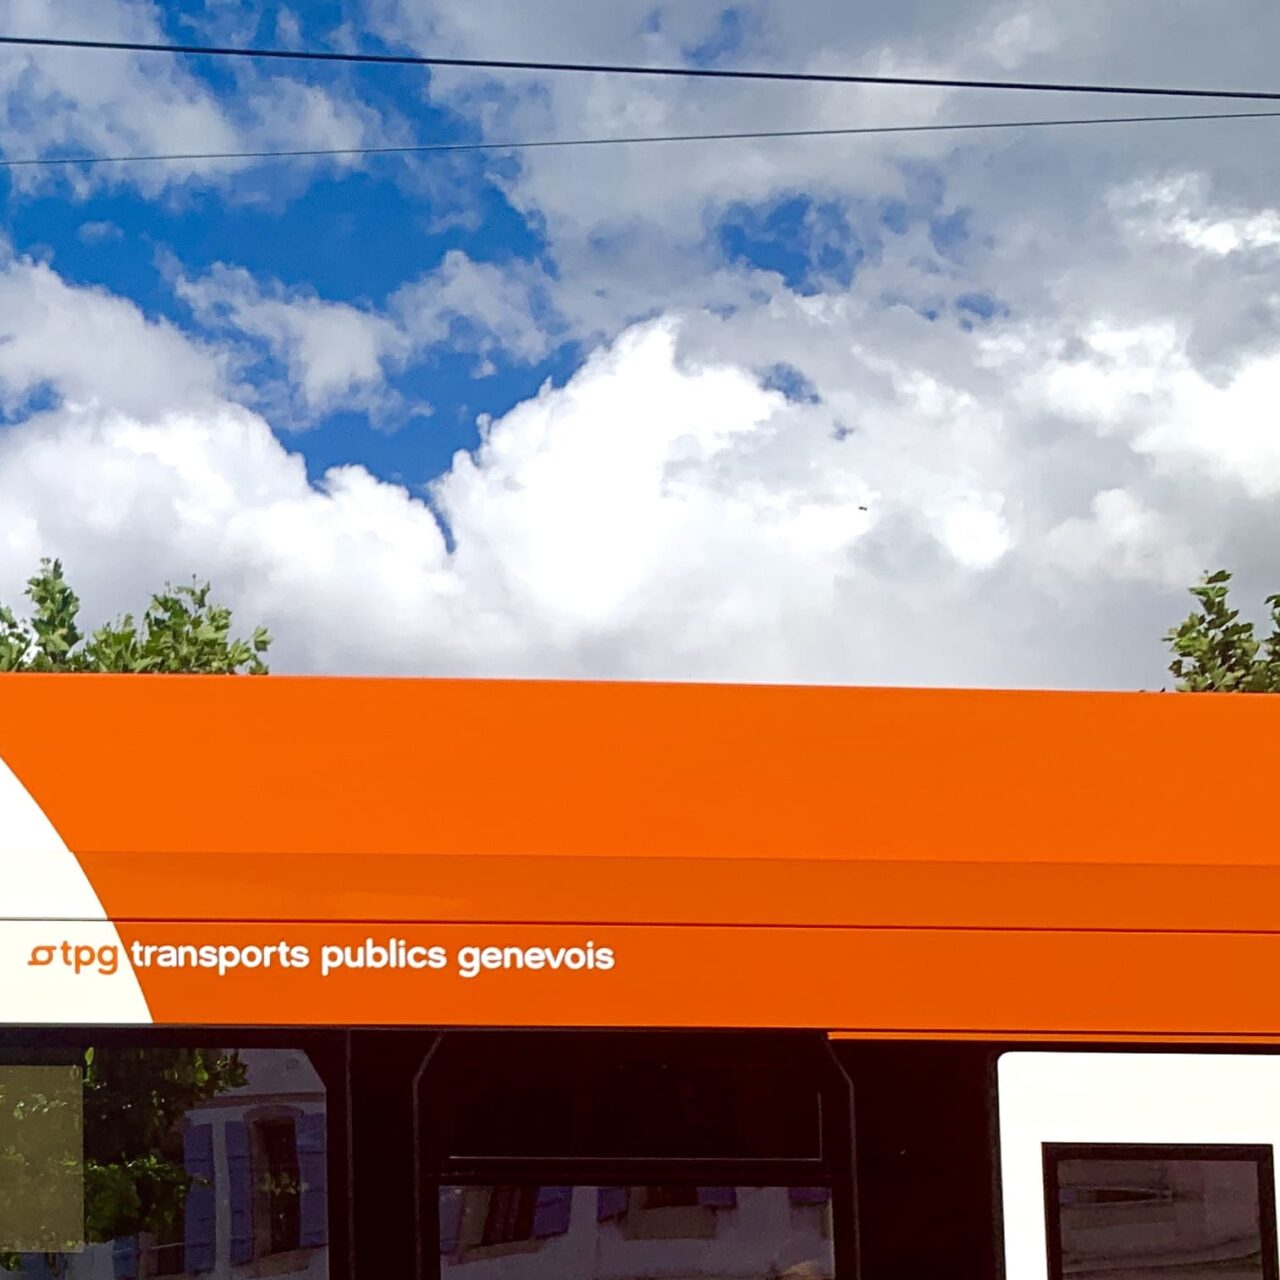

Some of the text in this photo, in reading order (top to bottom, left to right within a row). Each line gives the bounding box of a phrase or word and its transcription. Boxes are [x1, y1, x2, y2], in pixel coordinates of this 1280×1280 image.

[62, 938, 616, 978] tpg transports publics genevois
